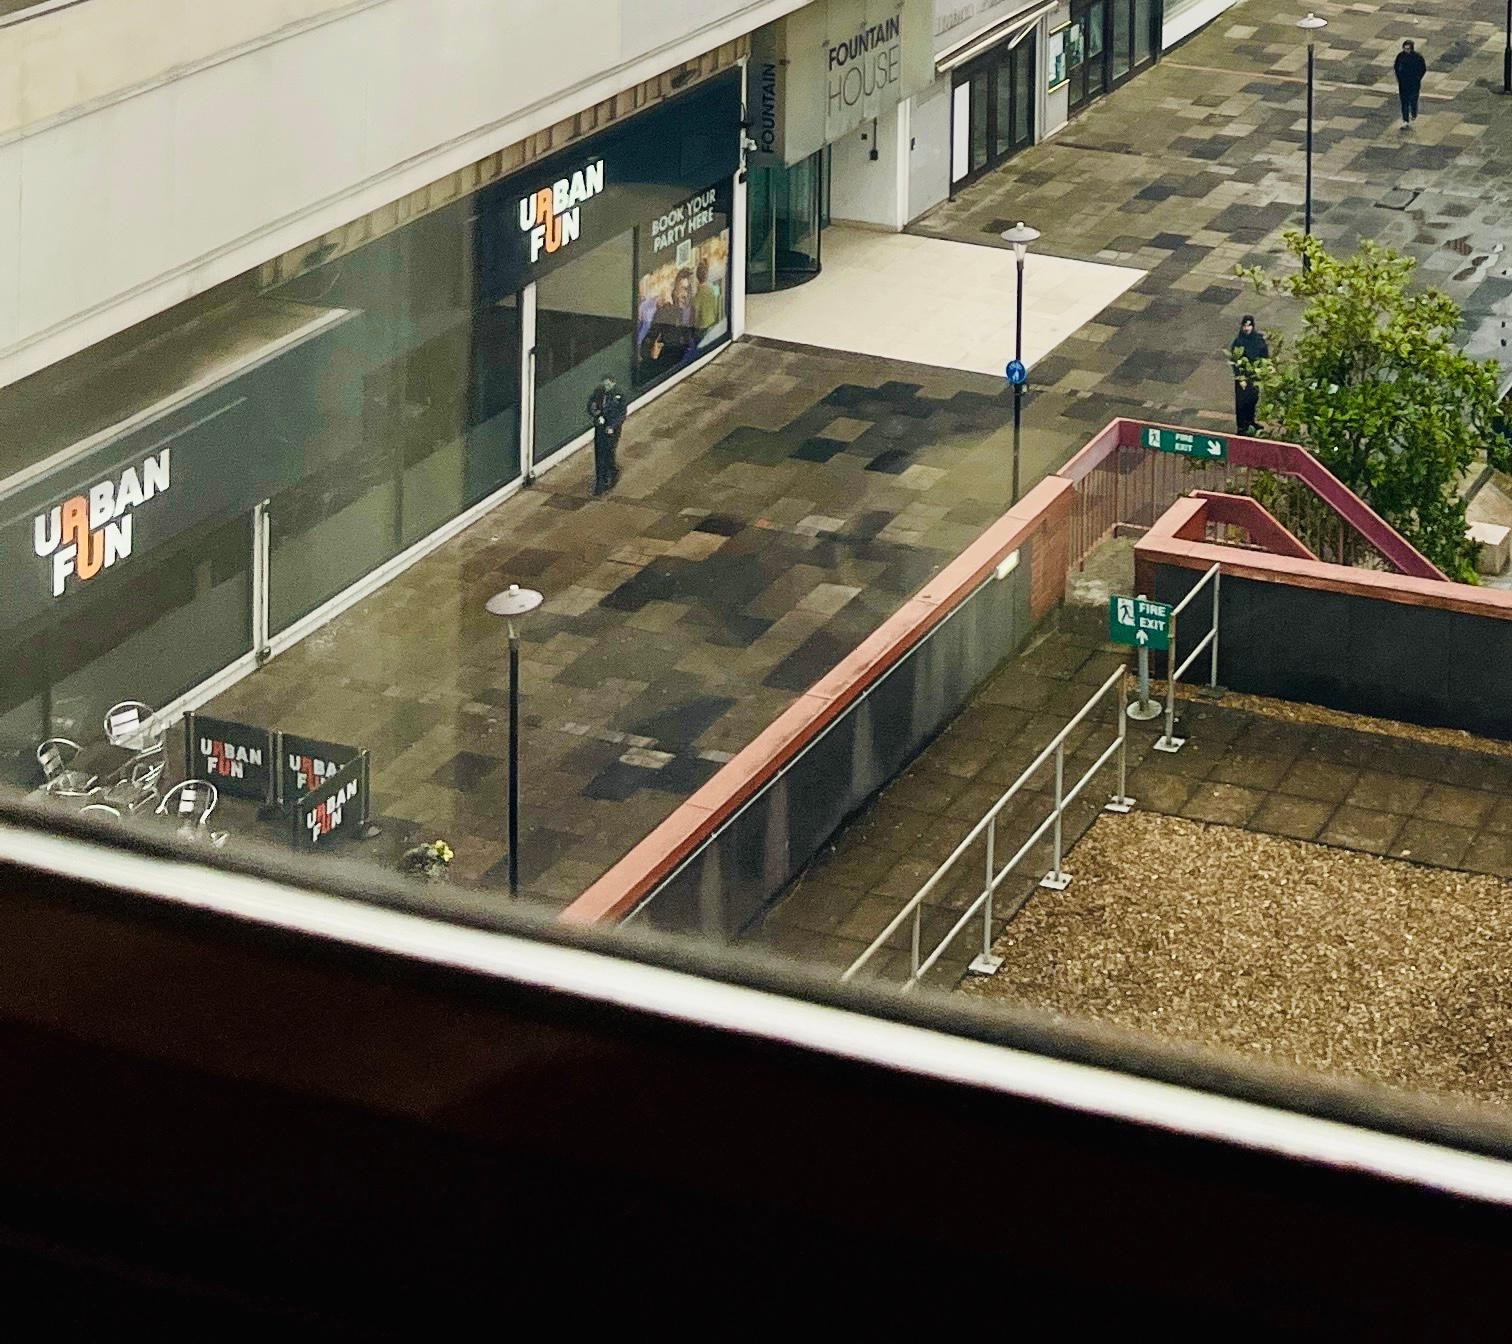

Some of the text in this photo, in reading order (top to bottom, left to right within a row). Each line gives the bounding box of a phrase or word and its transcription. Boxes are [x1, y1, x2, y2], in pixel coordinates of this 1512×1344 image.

[828, 14, 901, 72] FOUNTAIN
[827, 44, 899, 118] HOUSE
[761, 62, 776, 154] FOUNTAIN
[519, 159, 604, 232] URBAN
[651, 188, 717, 237] BOOK YOUR
[530, 206, 581, 263] FUN
[653, 206, 715, 254] PARTY HERE
[1174, 442, 1193, 453] EXIT
[1175, 432, 1194, 443] FIRE
[34, 448, 171, 557] URBAN
[53, 513, 133, 597] FUN
[1138, 601, 1167, 618] FIRE
[1139, 616, 1166, 632] EXIT
[200, 737, 263, 766] URBAN
[207, 756, 244, 779] FUN
[289, 754, 346, 778] URBA
[297, 772, 326, 791] FU
[306, 778, 358, 830] URBAN
[312, 806, 342, 843] FUN
